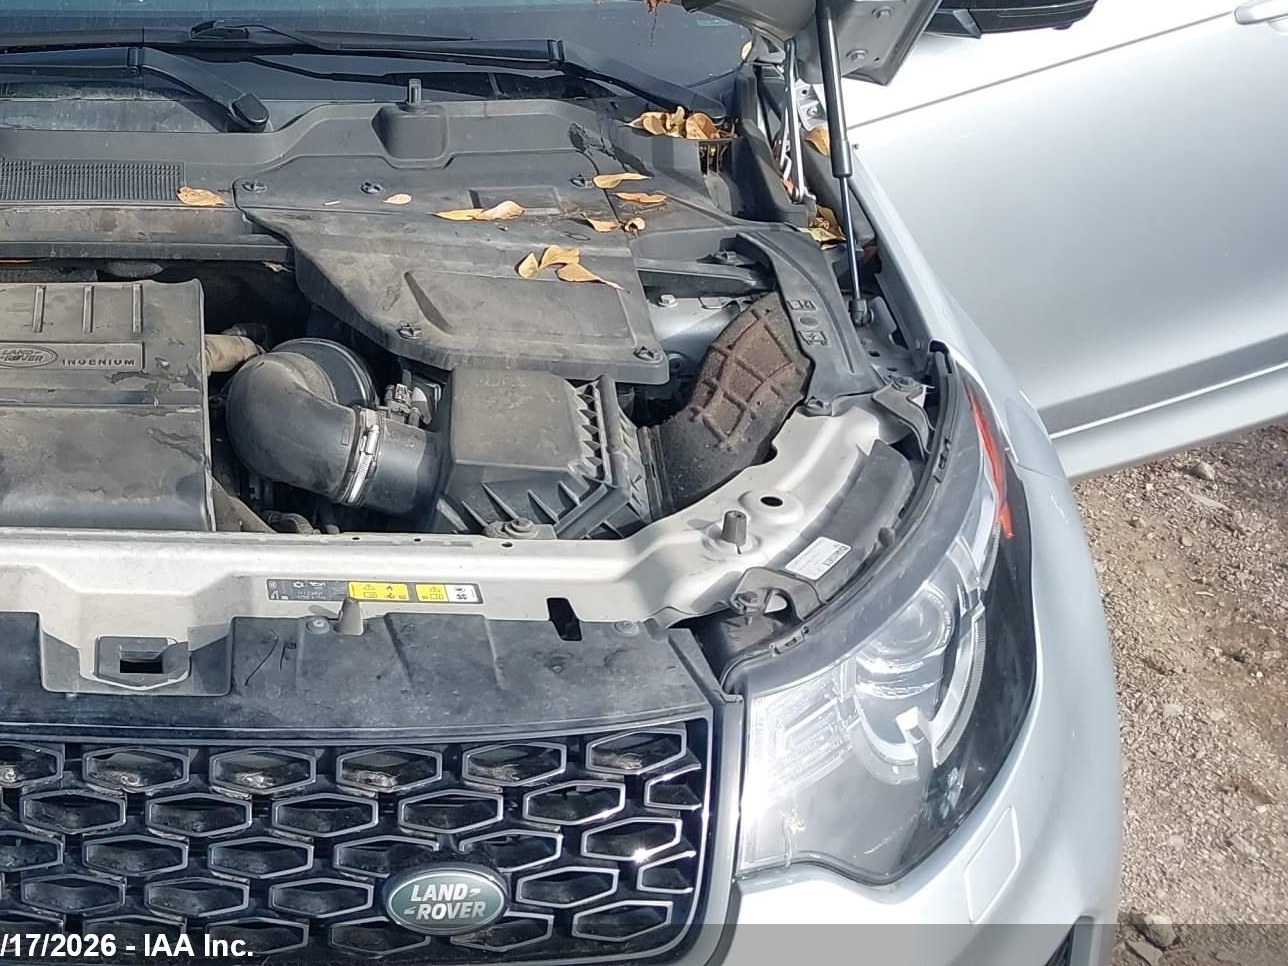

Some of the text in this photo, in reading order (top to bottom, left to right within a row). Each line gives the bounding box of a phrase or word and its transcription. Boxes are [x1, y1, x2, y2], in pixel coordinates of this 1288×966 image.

[4, 354, 44, 362] ROVER
[410, 884, 468, 902] LAND
[416, 902, 487, 920] ROVER
